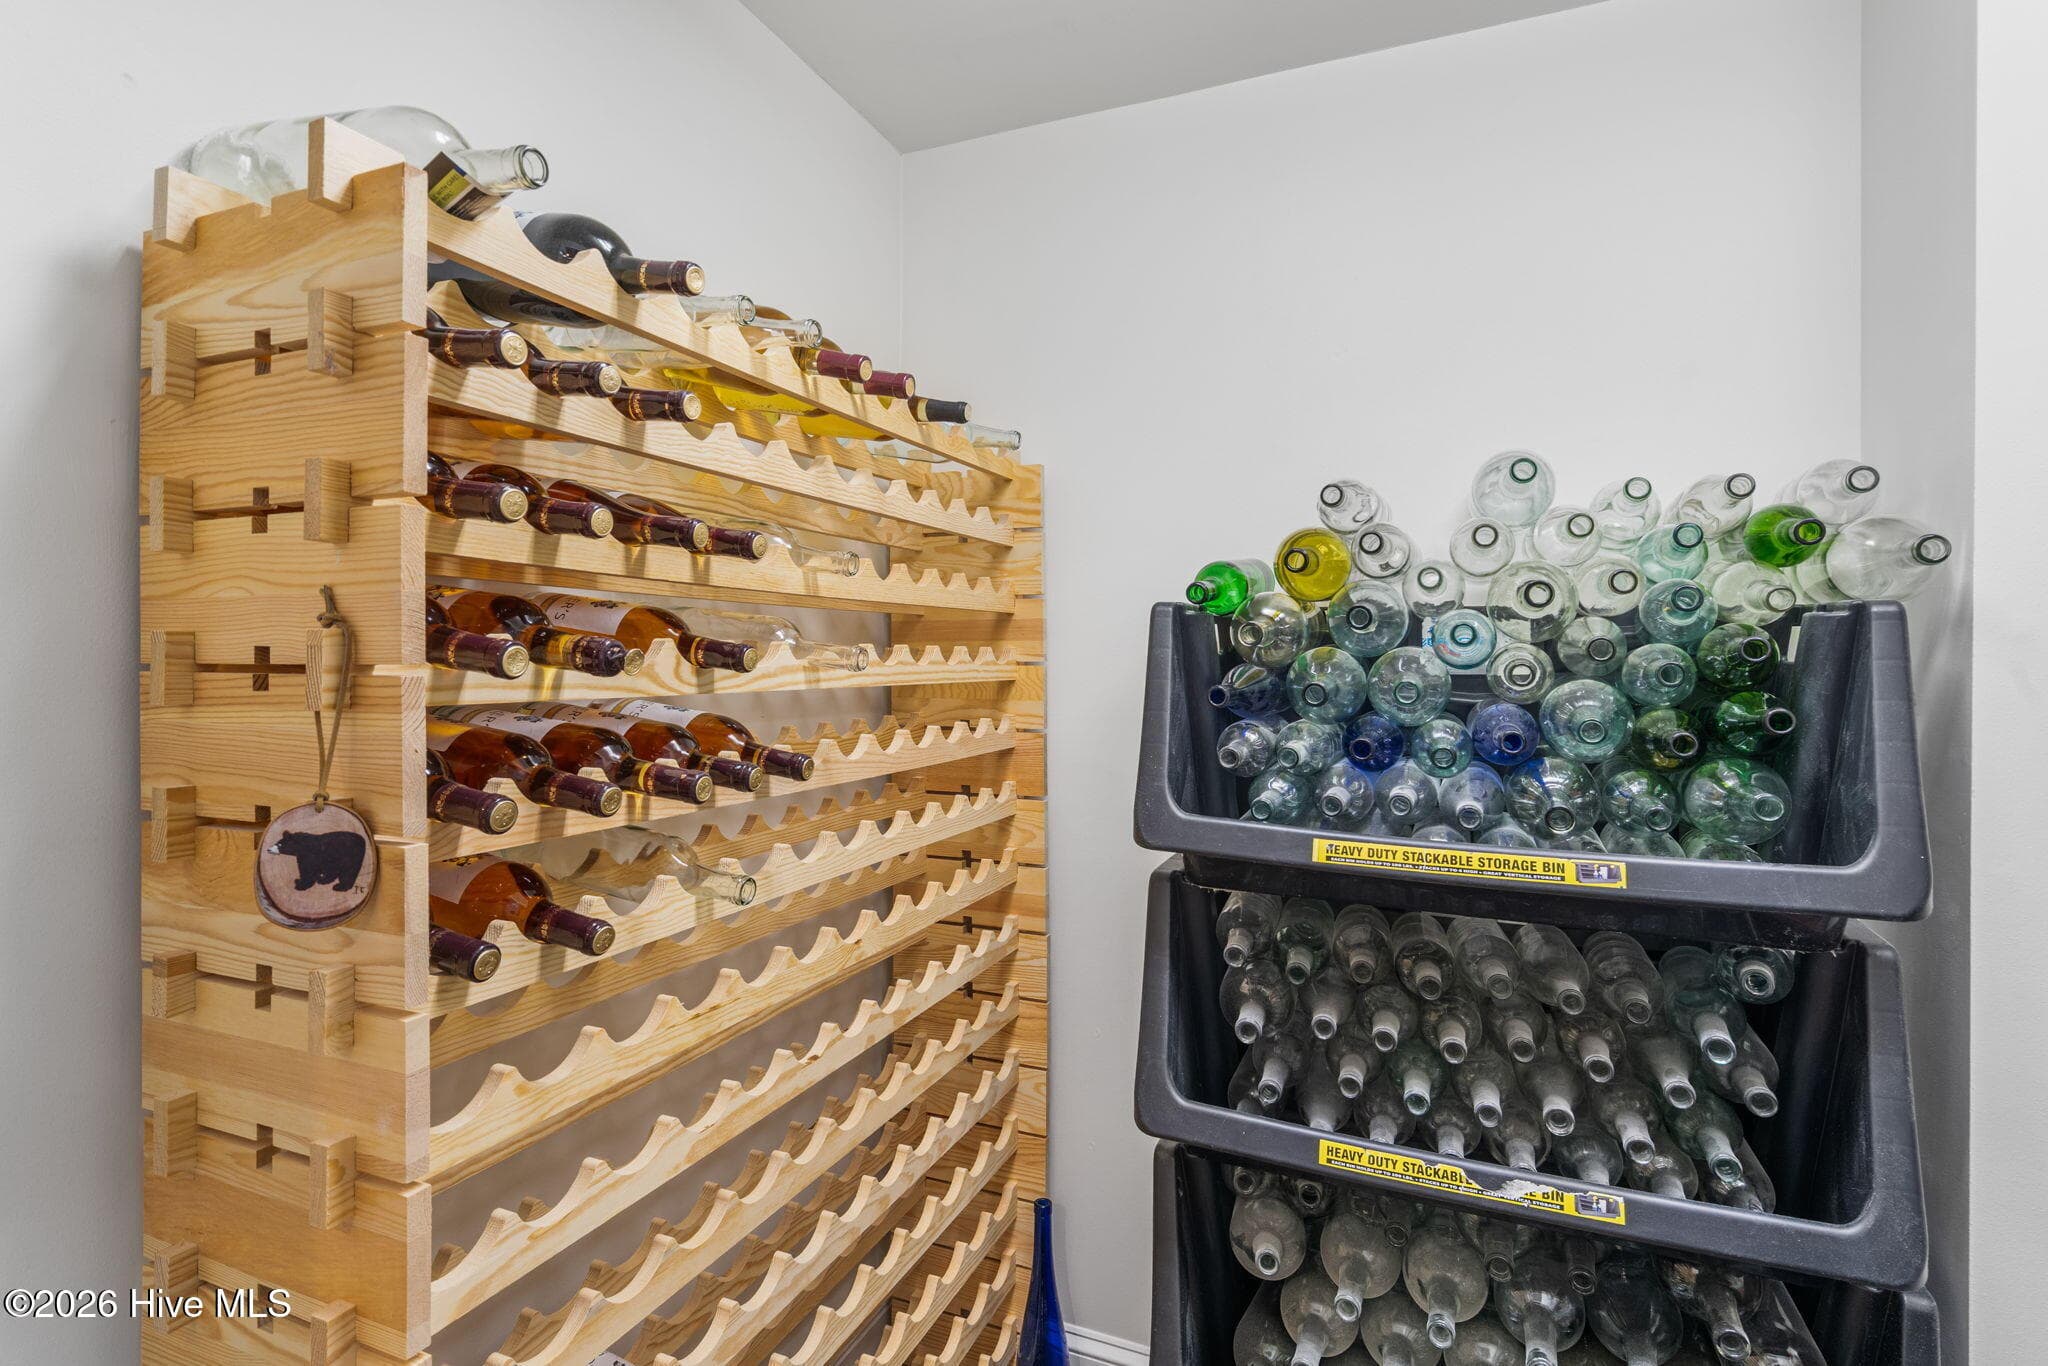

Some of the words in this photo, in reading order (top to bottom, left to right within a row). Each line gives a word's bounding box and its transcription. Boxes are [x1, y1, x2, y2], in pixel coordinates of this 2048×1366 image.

[1368, 848, 1398, 860] DUTY
[1402, 851, 1473, 866] STACKABLE
[1478, 856, 1538, 871] STORAGE
[1543, 862, 1565, 873] BIN
[1326, 1146, 1364, 1163] HEAVY
[1368, 1154, 1398, 1170] DUTY
